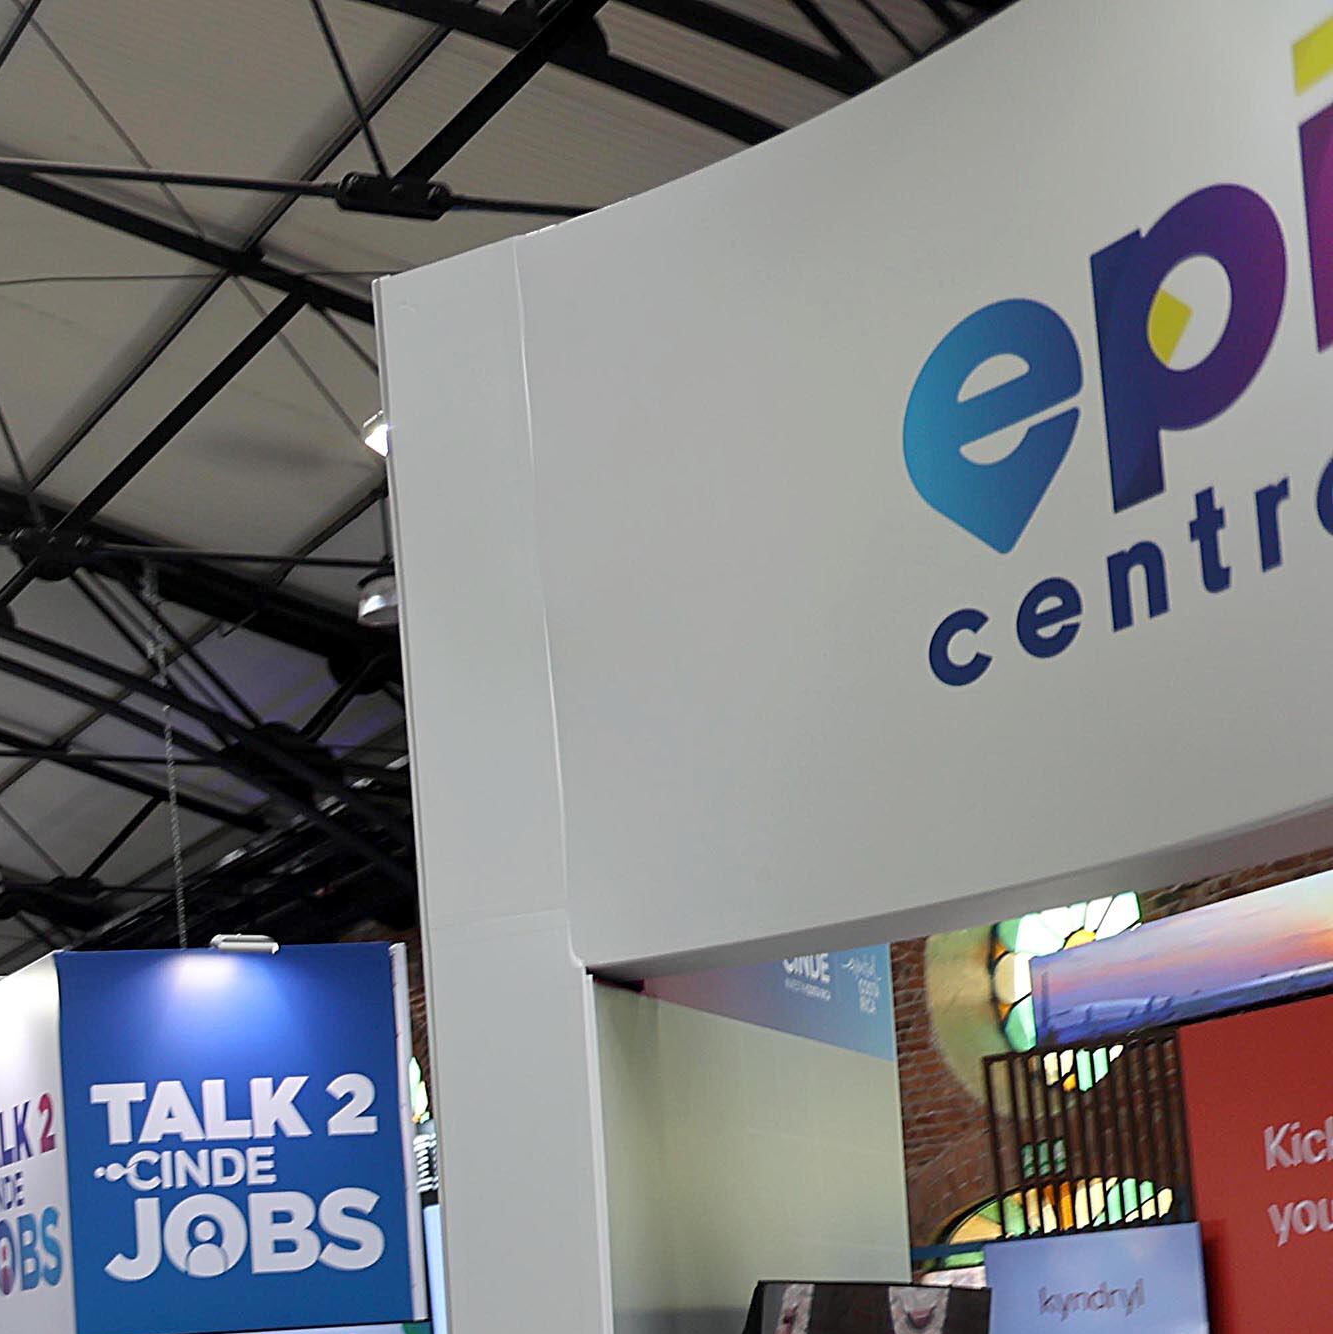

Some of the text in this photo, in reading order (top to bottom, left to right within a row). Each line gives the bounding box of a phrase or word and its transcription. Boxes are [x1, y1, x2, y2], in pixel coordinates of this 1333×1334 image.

[929, 462, 1333, 686] centr
[39, 1093, 56, 1153] 2
[90, 1073, 378, 1145] TALK 2
[126, 1146, 277, 1191] CINDE
[104, 1187, 386, 1282] JOBS
[1039, 1278, 1145, 1321] kyndryl
